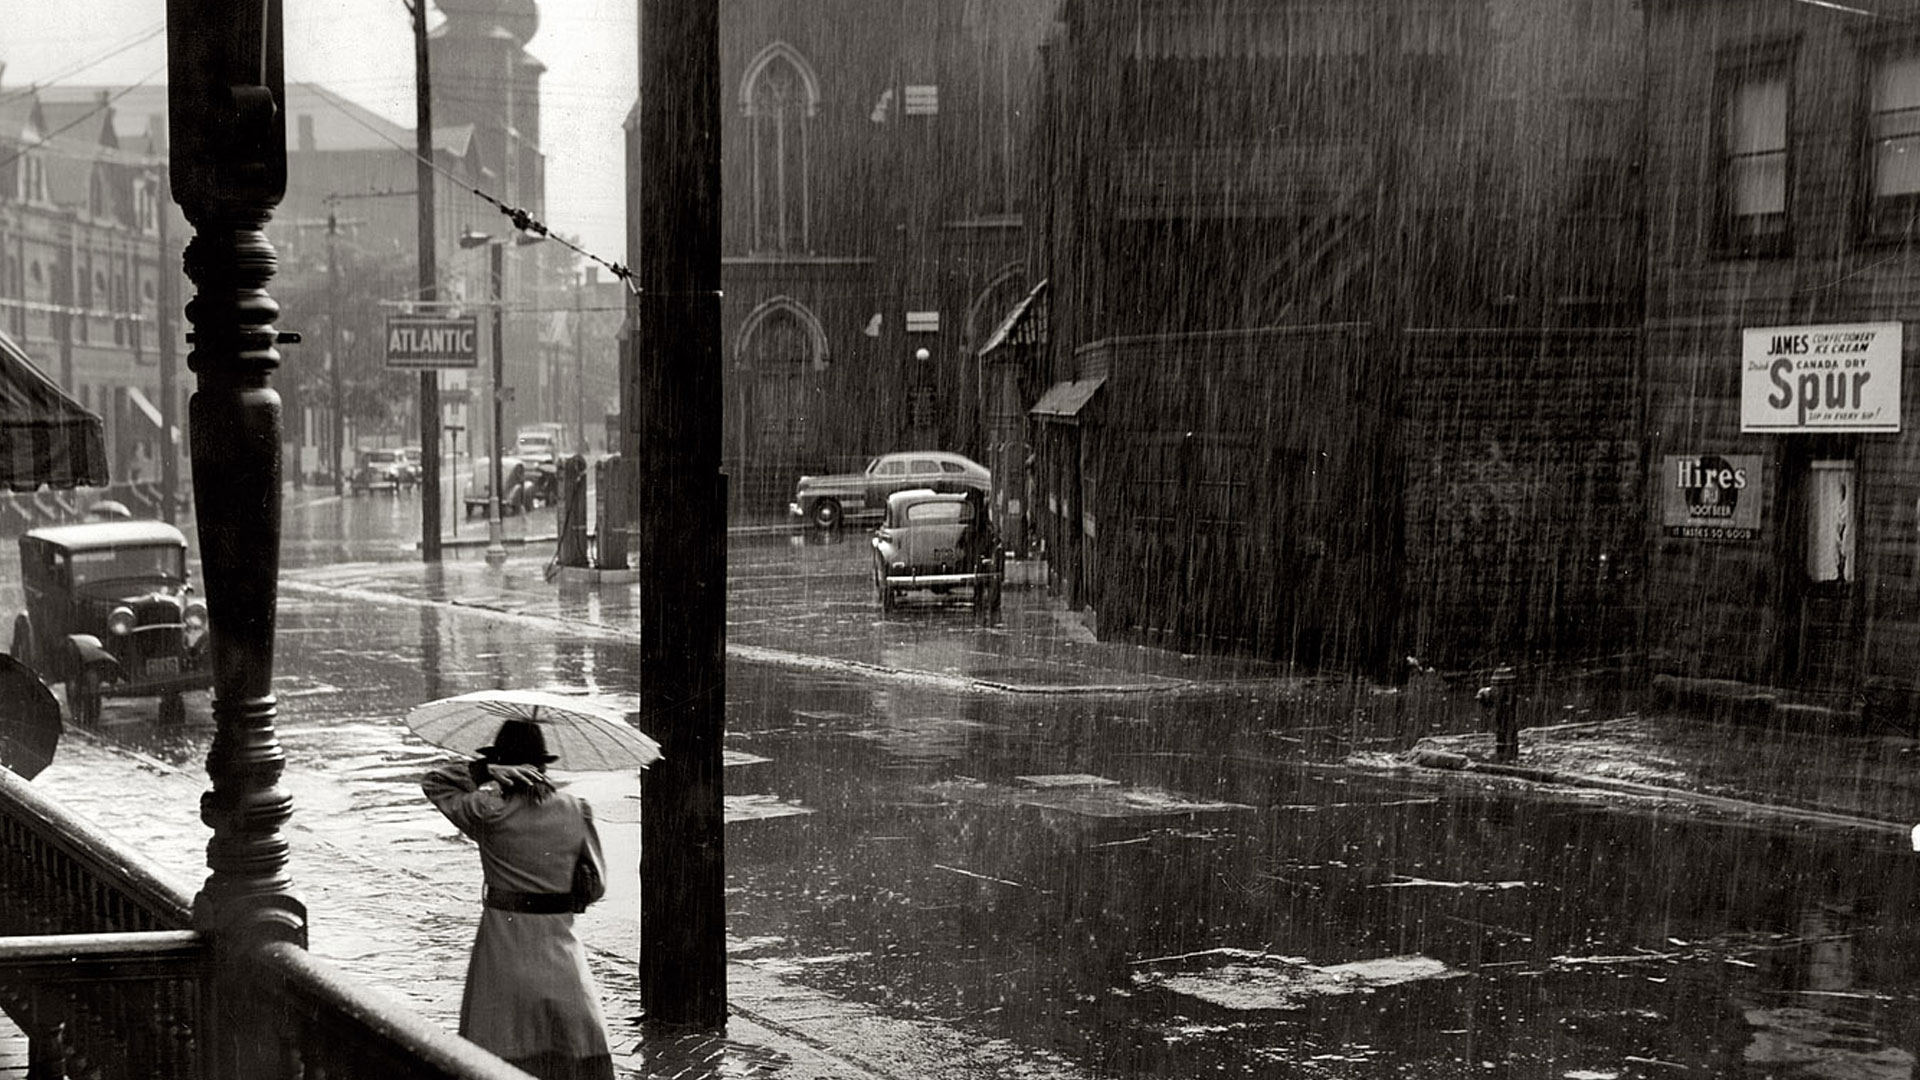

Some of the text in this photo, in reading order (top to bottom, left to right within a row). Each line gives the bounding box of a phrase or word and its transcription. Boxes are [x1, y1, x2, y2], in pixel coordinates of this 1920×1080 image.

[389, 328, 474, 352] ATLANTIC
[1767, 333, 1809, 355] JAMES
[1813, 331, 1876, 344] CONFECTIONERY
[1832, 342, 1869, 354] CREAM
[1796, 358, 1867, 369] CANADA DRY
[1768, 358, 1871, 426] Spur
[1834, 412, 1858, 420] EVERY
[1677, 459, 1746, 489] Hires
[1712, 528, 1723, 538] SO
[1726, 528, 1752, 539] GOOD
